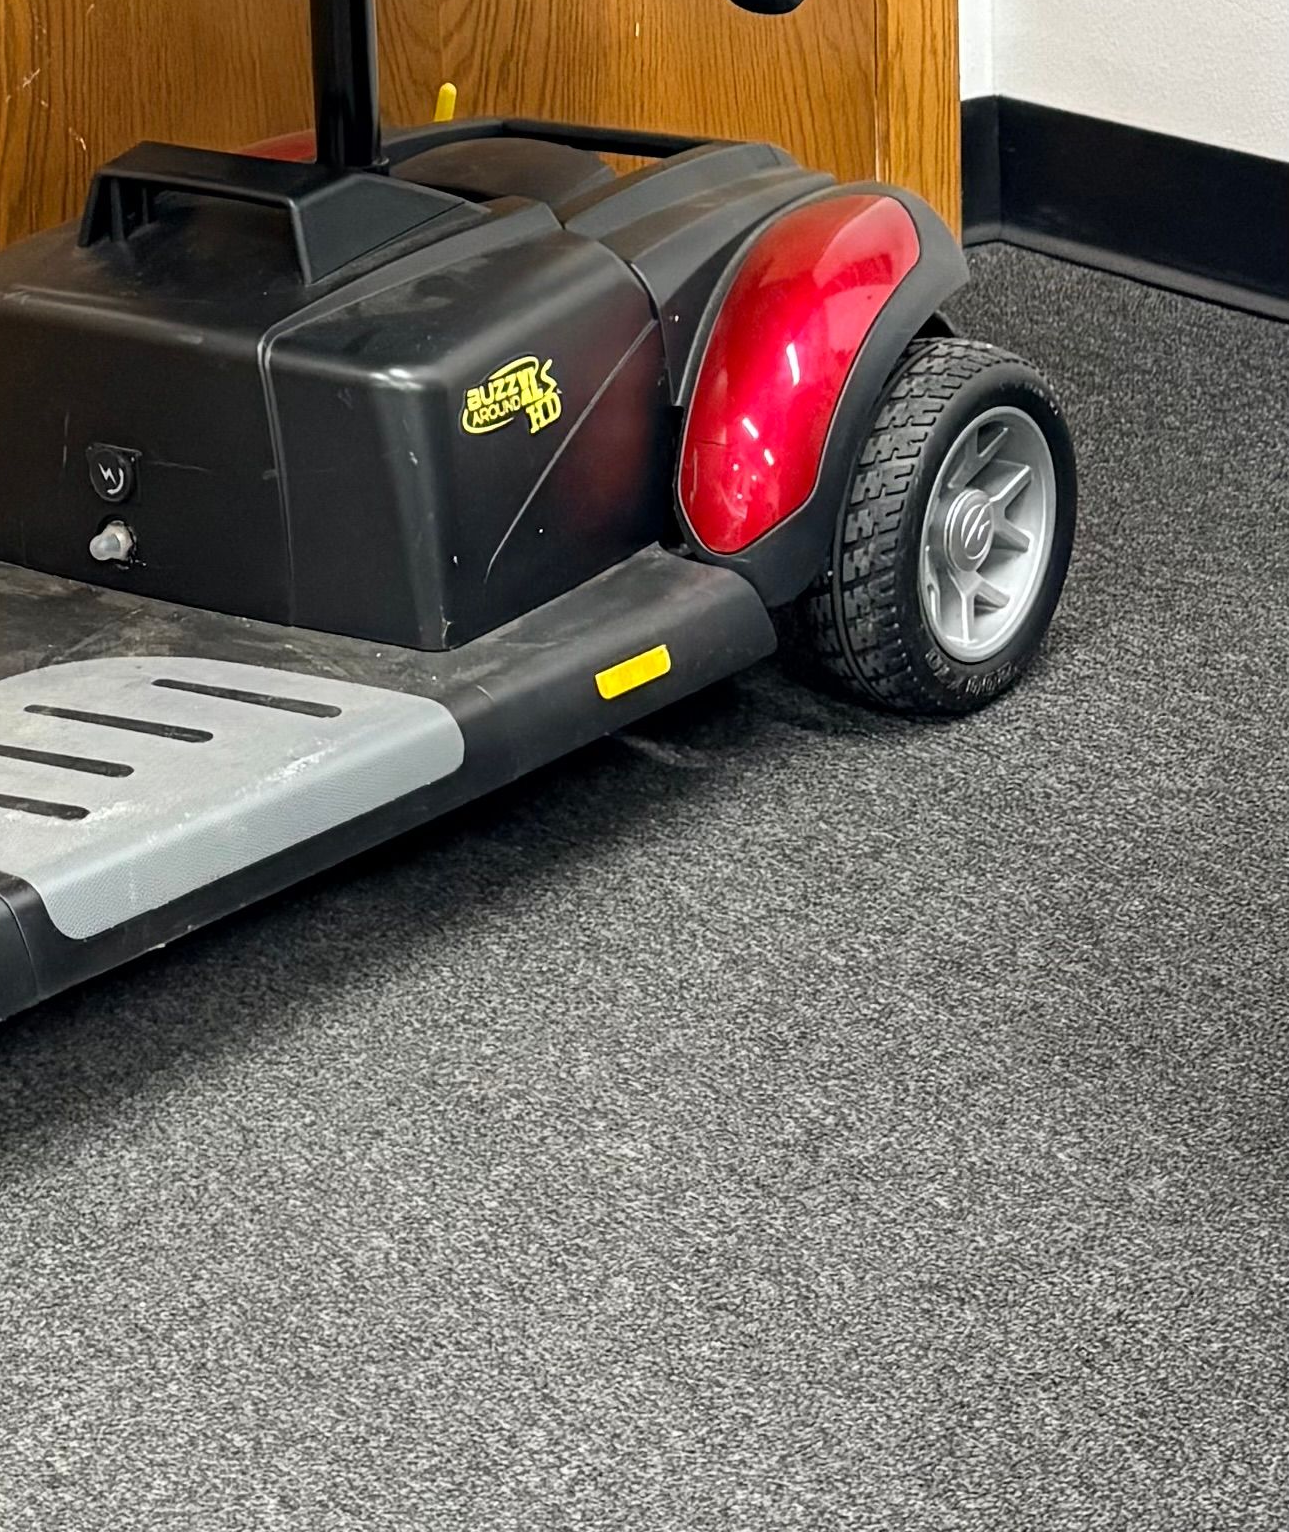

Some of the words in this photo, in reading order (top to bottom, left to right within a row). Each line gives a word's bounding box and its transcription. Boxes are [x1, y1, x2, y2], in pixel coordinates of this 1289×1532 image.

[466, 373, 520, 412] BUZZ
[472, 394, 522, 427] AROUND
[525, 392, 562, 434] HD
